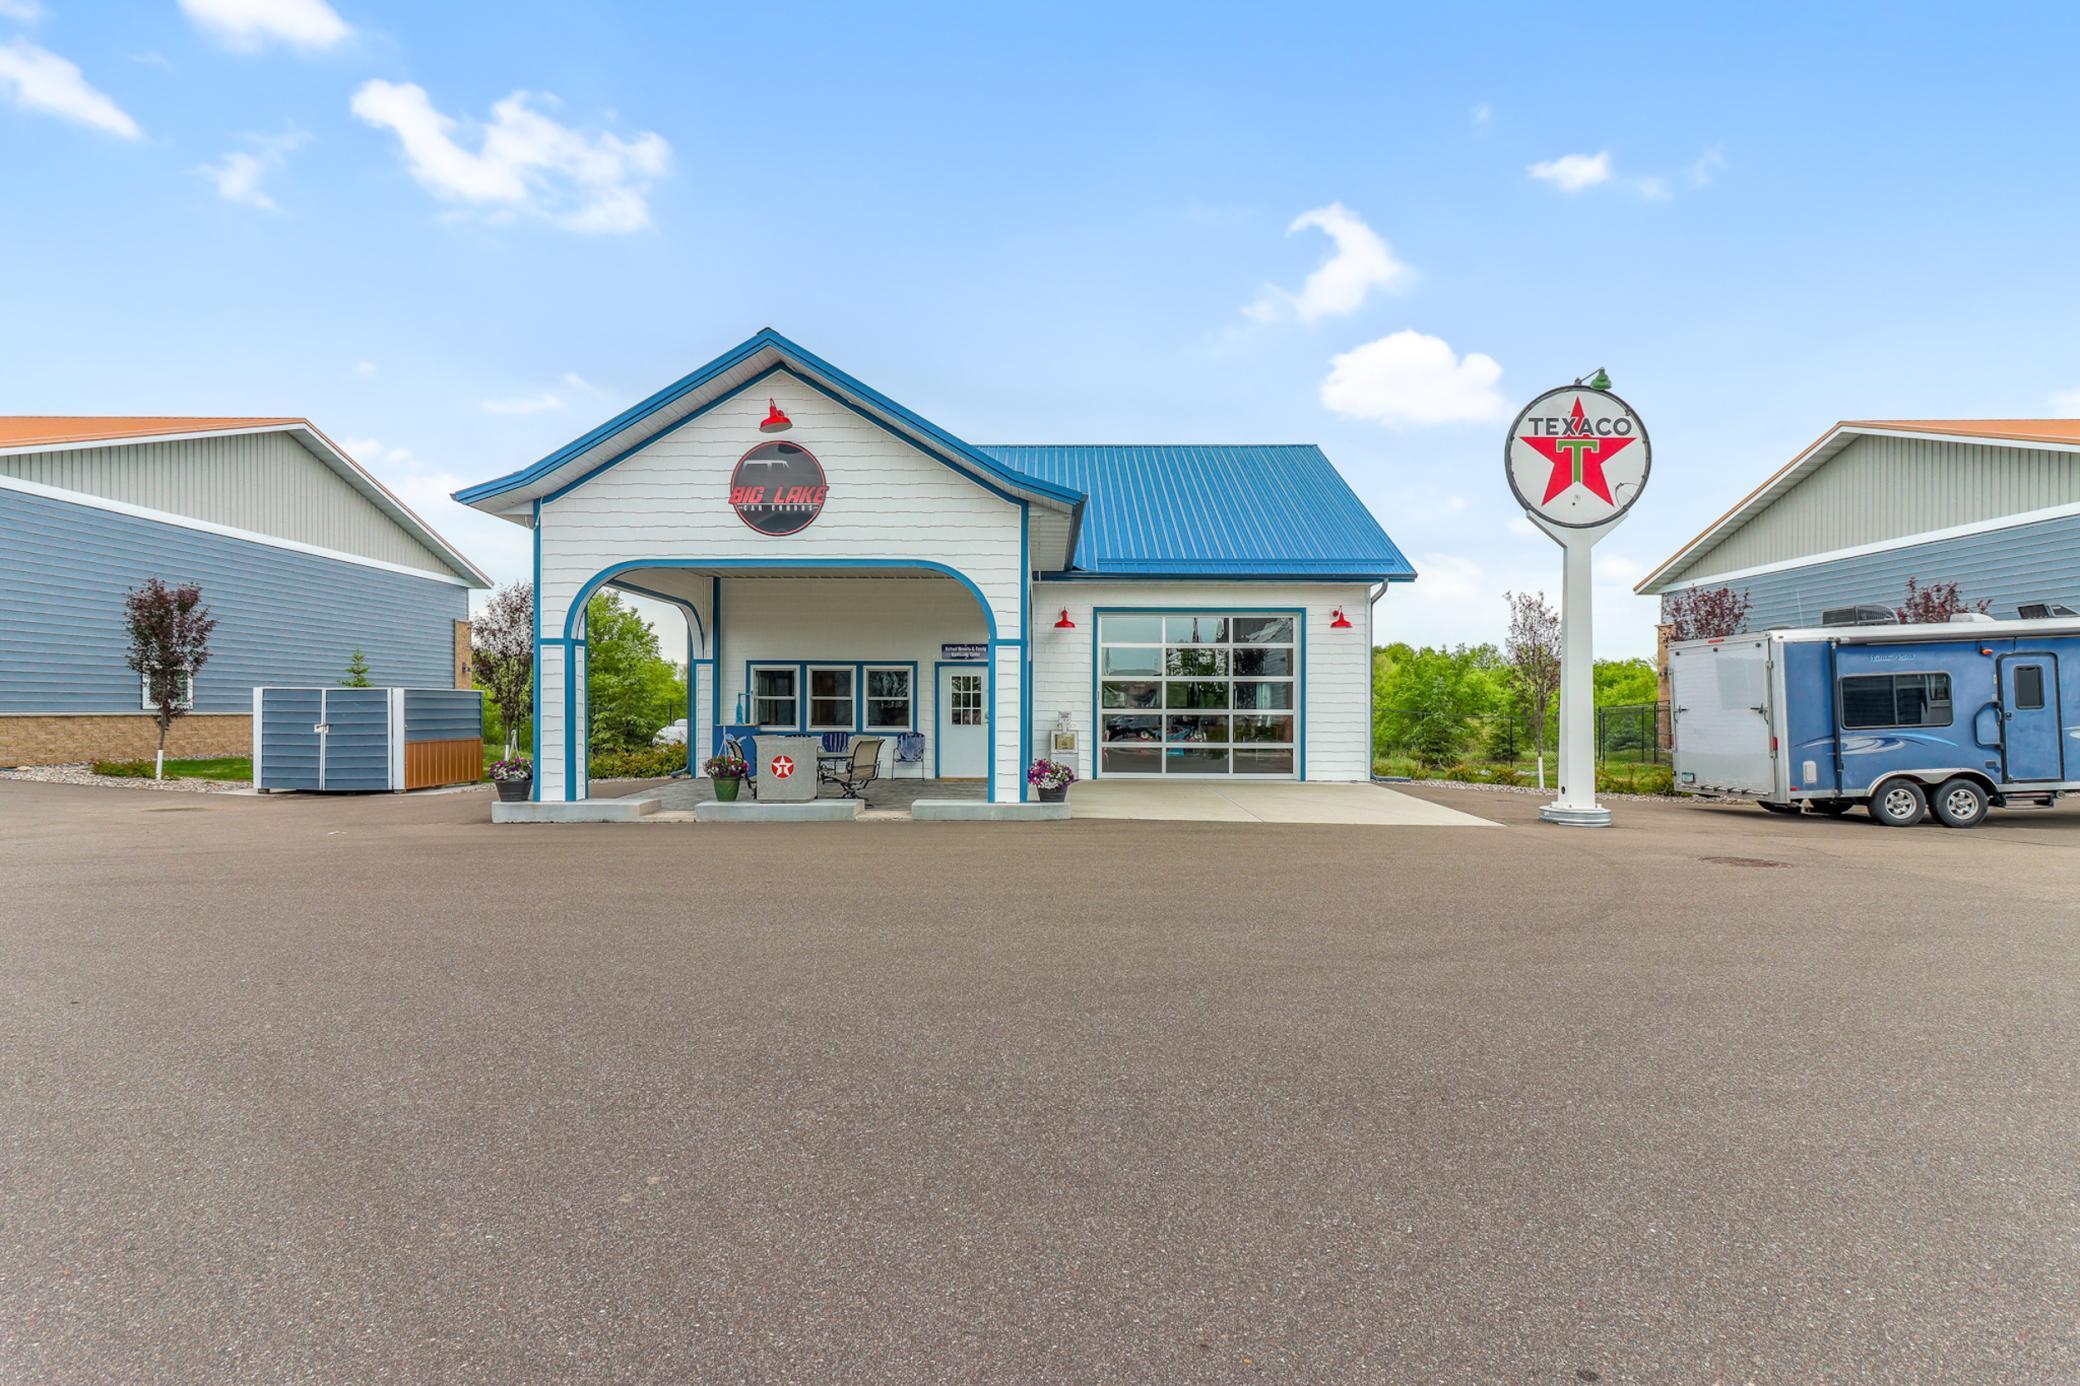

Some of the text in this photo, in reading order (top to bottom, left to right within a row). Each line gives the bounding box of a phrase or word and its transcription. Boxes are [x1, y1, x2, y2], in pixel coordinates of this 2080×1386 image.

[1528, 417, 1632, 436] TEXACO
[729, 485, 830, 504] BIG LAKE
